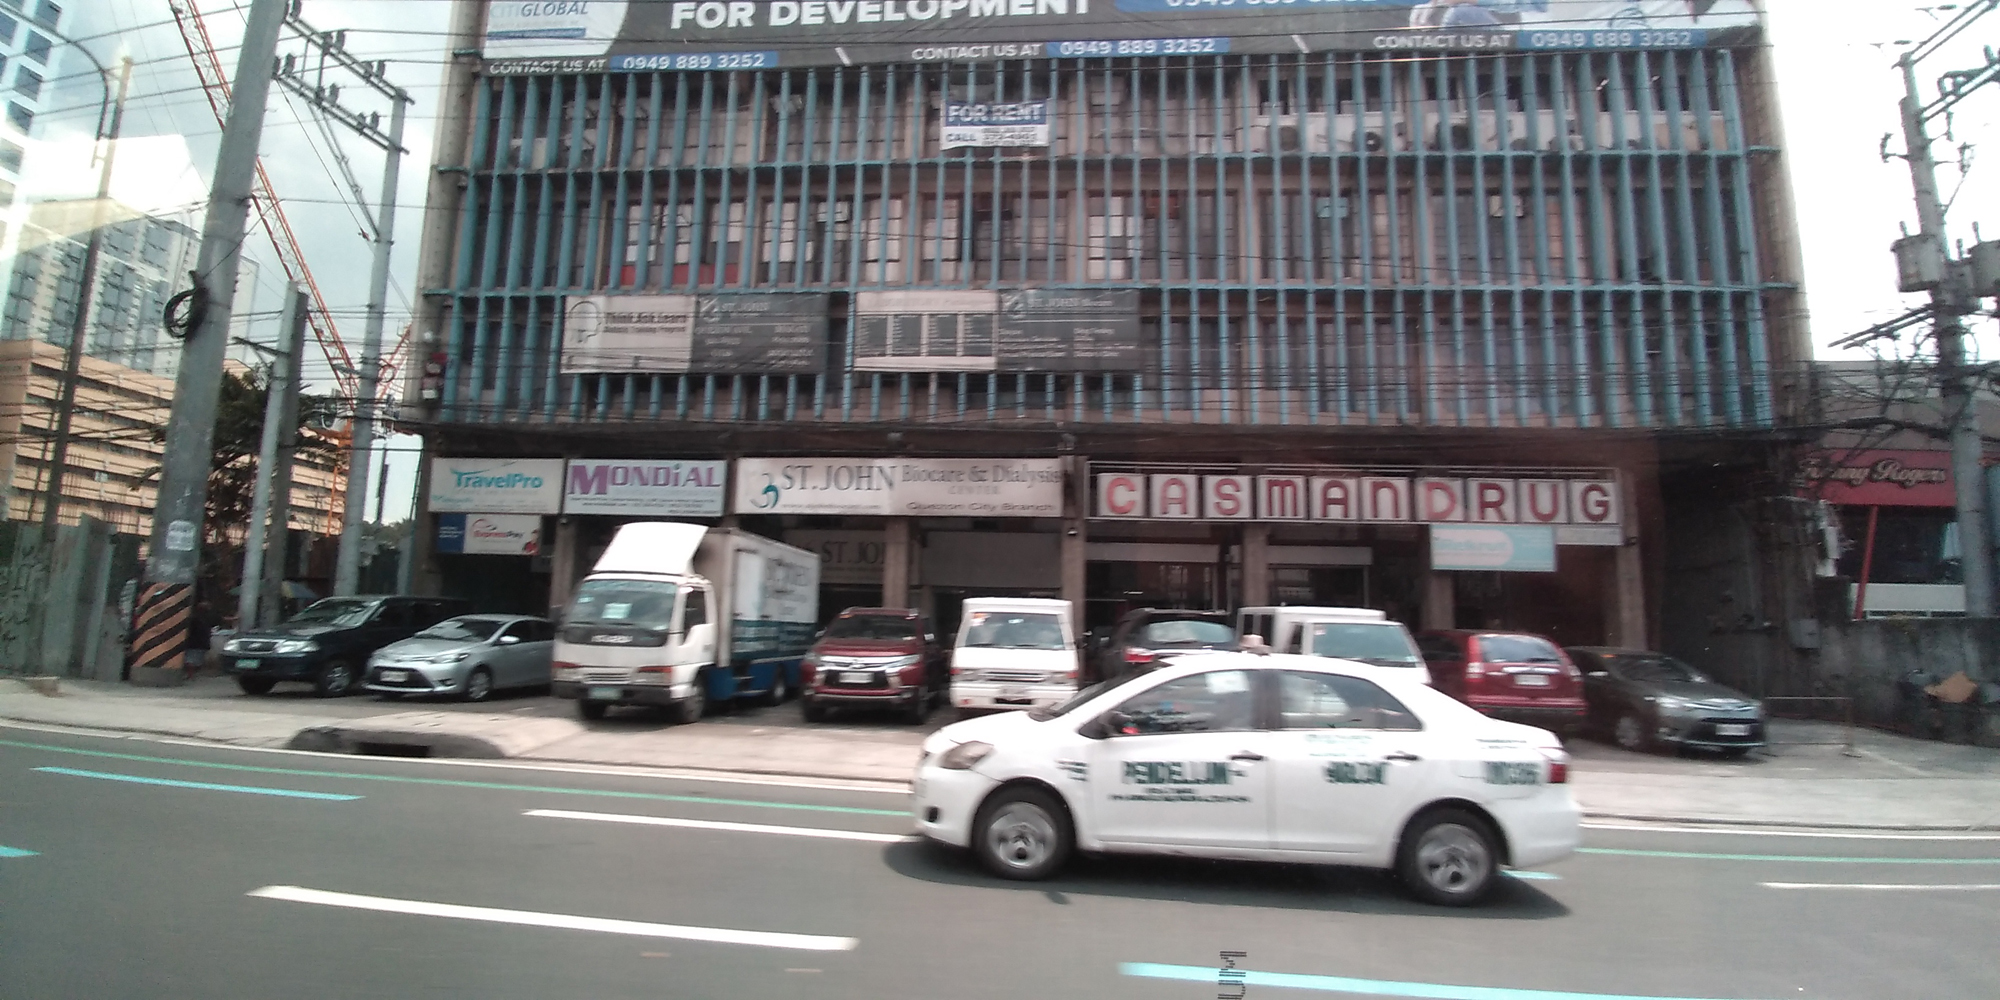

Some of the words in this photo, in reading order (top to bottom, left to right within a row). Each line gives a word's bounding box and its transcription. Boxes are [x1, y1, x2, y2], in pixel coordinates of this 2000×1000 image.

[670, 2, 756, 29] FOR
[911, 46, 991, 60] CONTACT
[993, 44, 1018, 57] US
[1019, 43, 1042, 56] AT
[1060, 41, 1112, 55] 0949
[1117, 40, 1156, 54] 889
[1163, 38, 1215, 53] 3252
[1373, 35, 1455, 48] CONTACT
[1460, 34, 1487, 47] US
[1489, 34, 1511, 47] AT
[1531, 33, 1586, 47] 0949
[1639, 32, 1693, 46] 3252
[489, 61, 560, 74] CONTACT
[562, 61, 584, 72] US
[585, 59, 607, 71] AT
[622, 55, 670, 69] 0949
[676, 54, 712, 68] 889
[717, 53, 765, 68] 3252
[450, 469, 543, 488] TravelPro
[902, 464, 965, 482] Biocare
